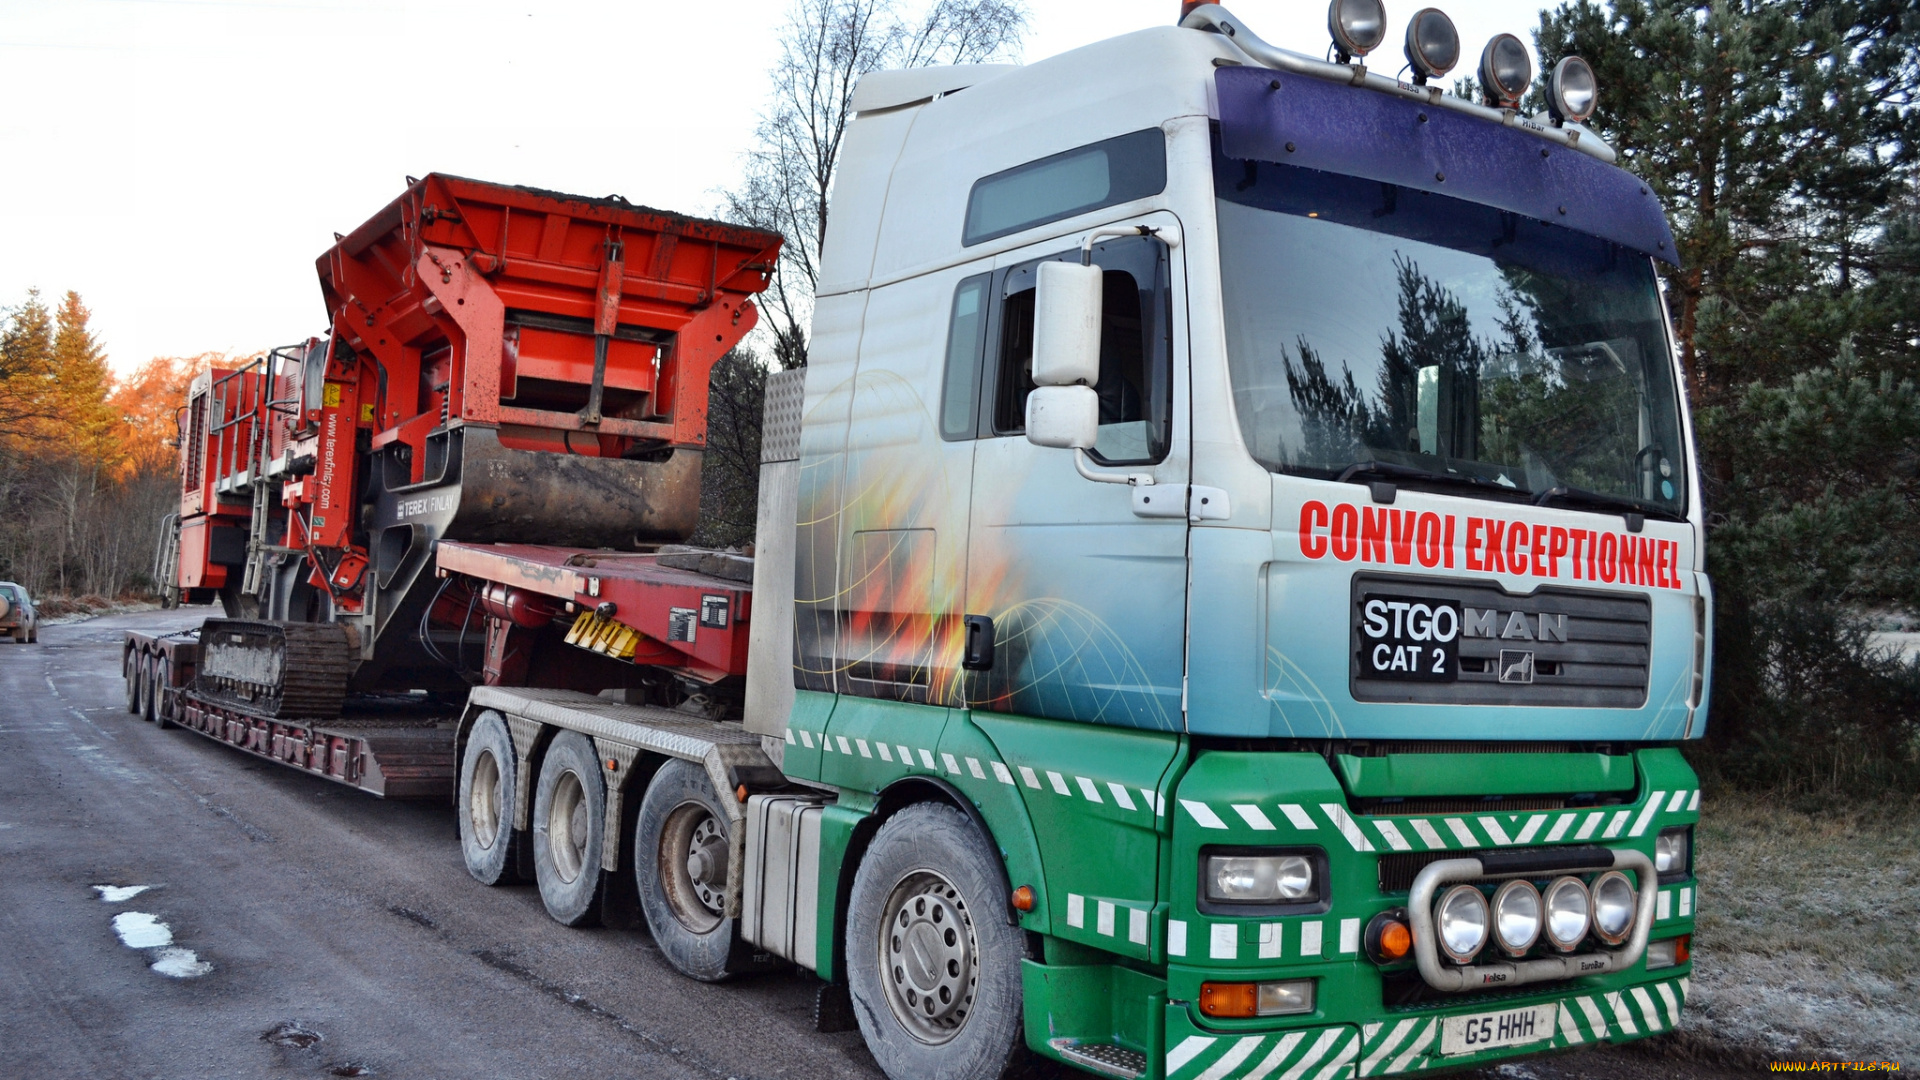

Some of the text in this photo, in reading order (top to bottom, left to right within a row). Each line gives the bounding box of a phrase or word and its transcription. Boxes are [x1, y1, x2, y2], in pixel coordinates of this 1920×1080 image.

[1522, 119, 1545, 132] HiBar
[321, 413, 338, 509] www.terexfinlay.com
[405, 494, 454, 517] TEREX FINLAY
[1298, 499, 1682, 590] CONVOI EXCEPTIONNEL
[1364, 599, 1459, 643] STGO
[1464, 607, 1569, 642] MAN
[1372, 643, 1446, 674] CAT 2
[1581, 961, 1605, 971] EuroBar
[1465, 1010, 1536, 1045] G5 HHH
